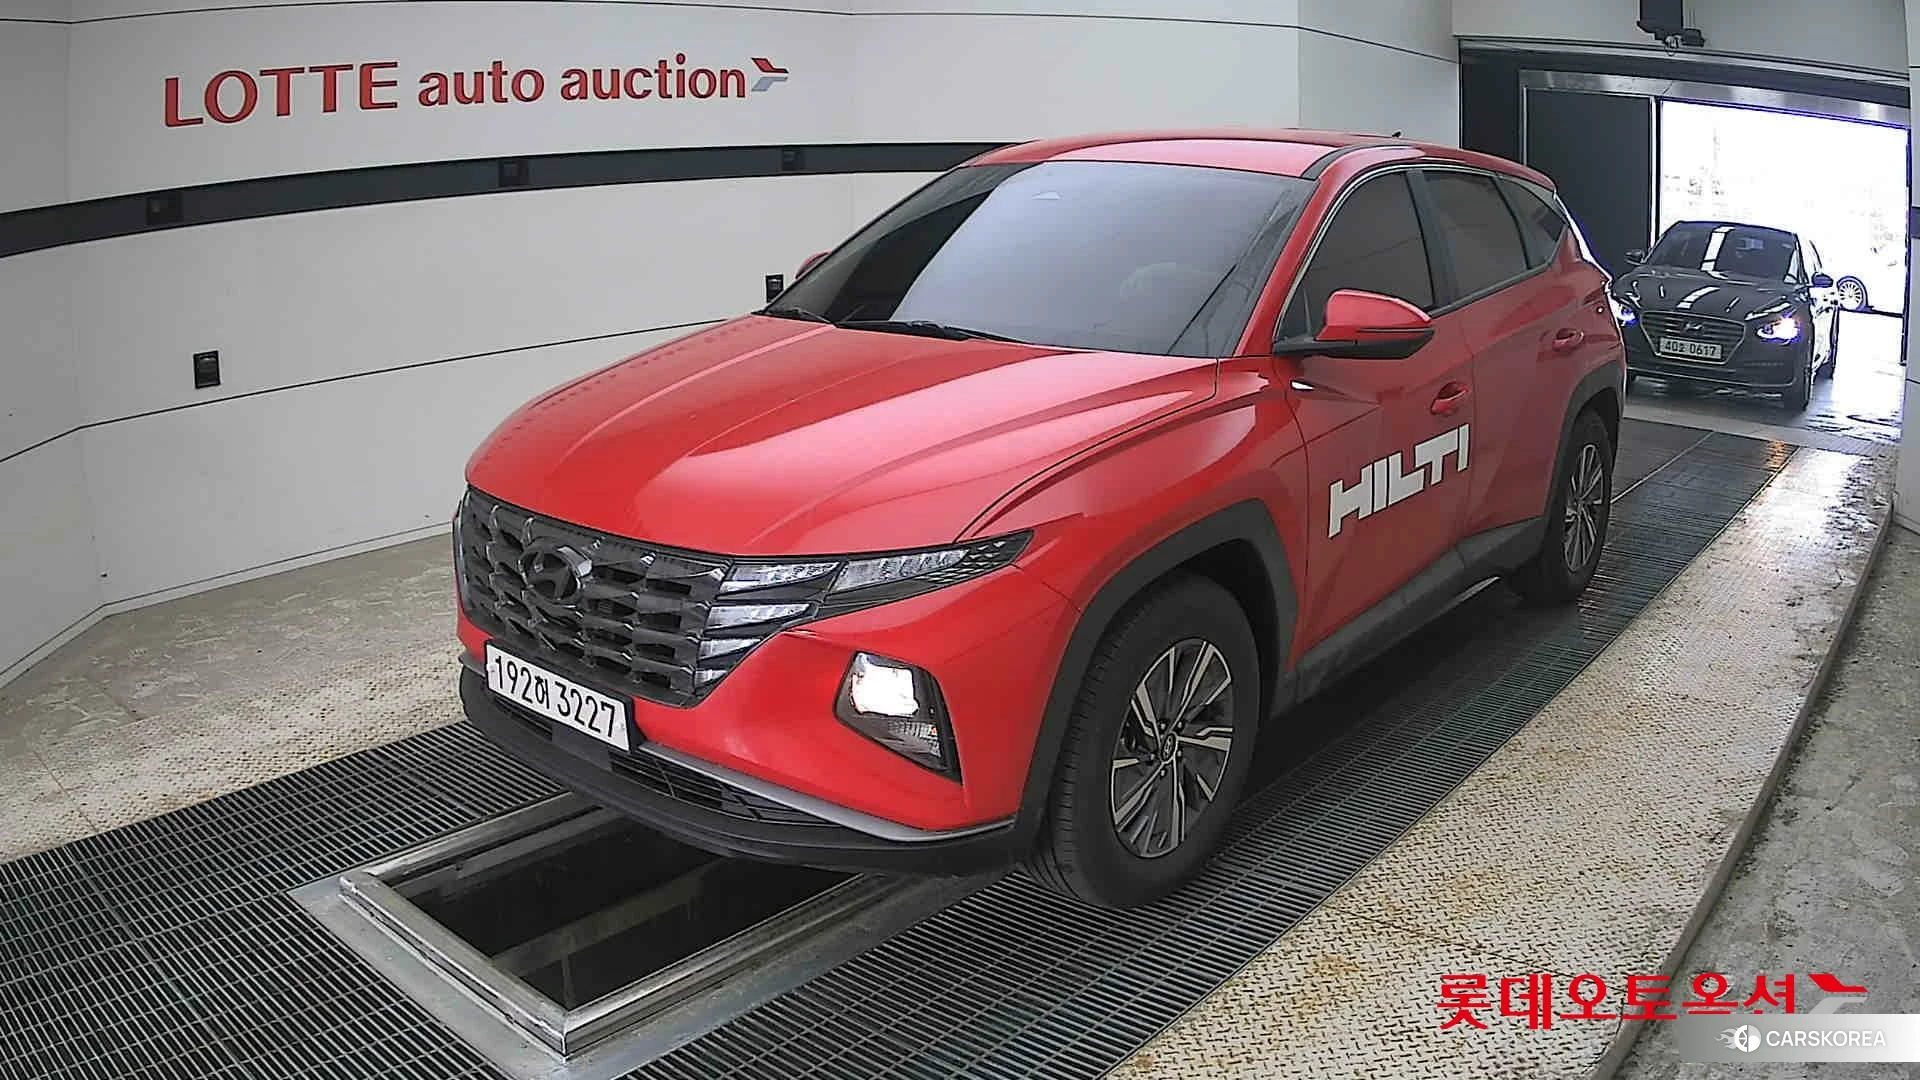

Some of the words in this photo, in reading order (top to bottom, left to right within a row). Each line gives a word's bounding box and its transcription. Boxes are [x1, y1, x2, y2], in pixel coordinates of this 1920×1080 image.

[165, 61, 399, 127] LOTTE
[418, 60, 545, 106] auto
[559, 53, 746, 100] auction
[1689, 343, 1716, 356] 0617
[1328, 423, 1469, 538] HILTI
[495, 655, 550, 710] 192허
[554, 680, 615, 737] 3227
